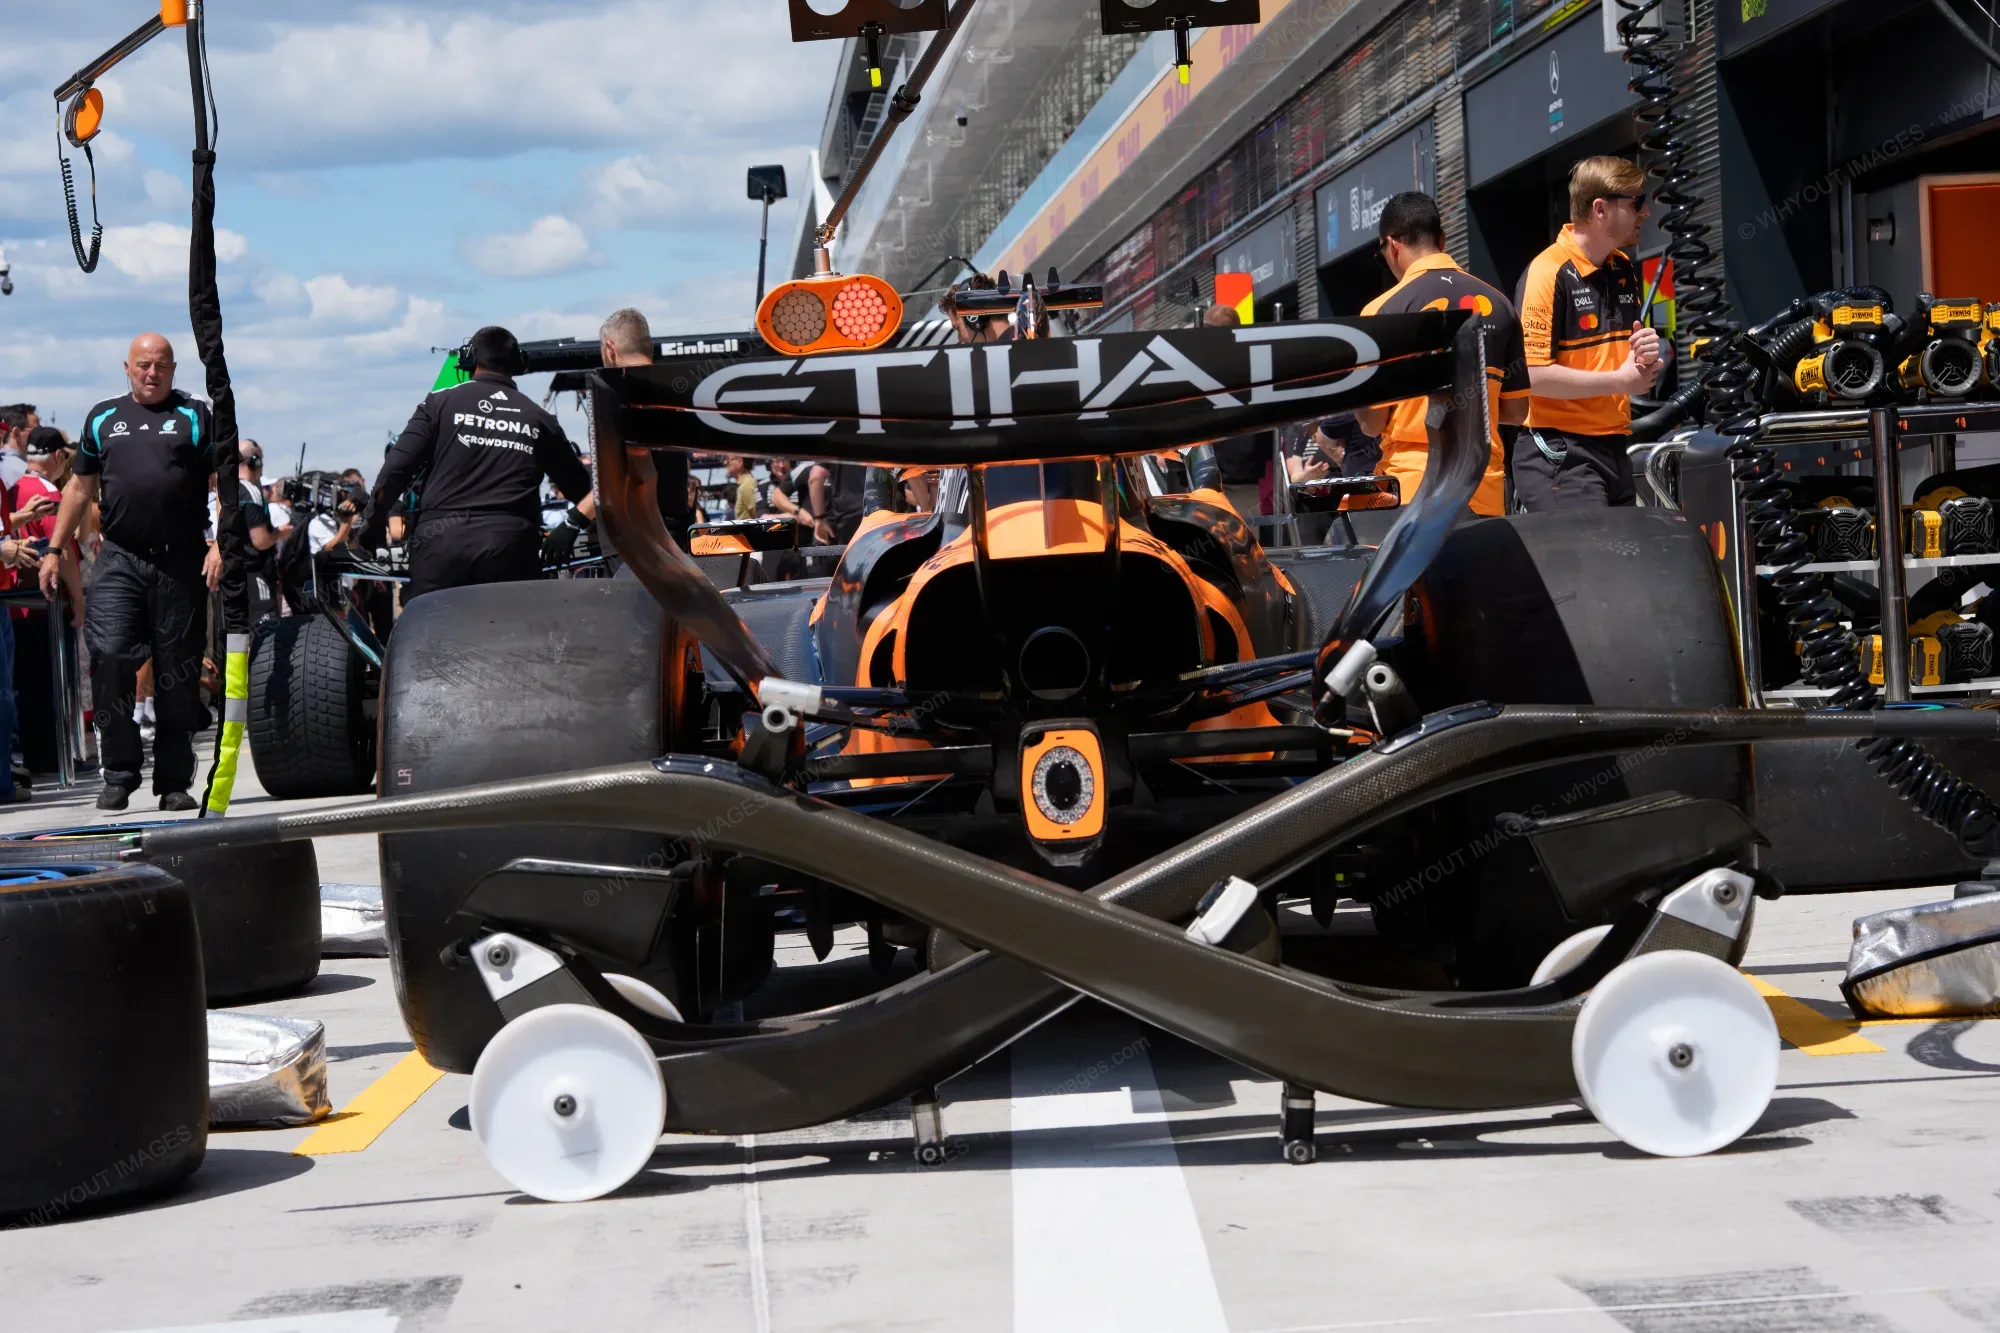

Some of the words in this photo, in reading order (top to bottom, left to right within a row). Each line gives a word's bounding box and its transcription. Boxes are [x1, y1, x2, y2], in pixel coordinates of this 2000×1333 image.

[1575, 296, 1593, 307] DELL
[1523, 320, 1547, 331] okta
[661, 339, 738, 356] Einhell
[692, 322, 1381, 436] ETIHAD
[454, 413, 540, 439] PETRONAS
[463, 434, 534, 455] CROWDSTRIKE
[397, 768, 412, 786] LR
